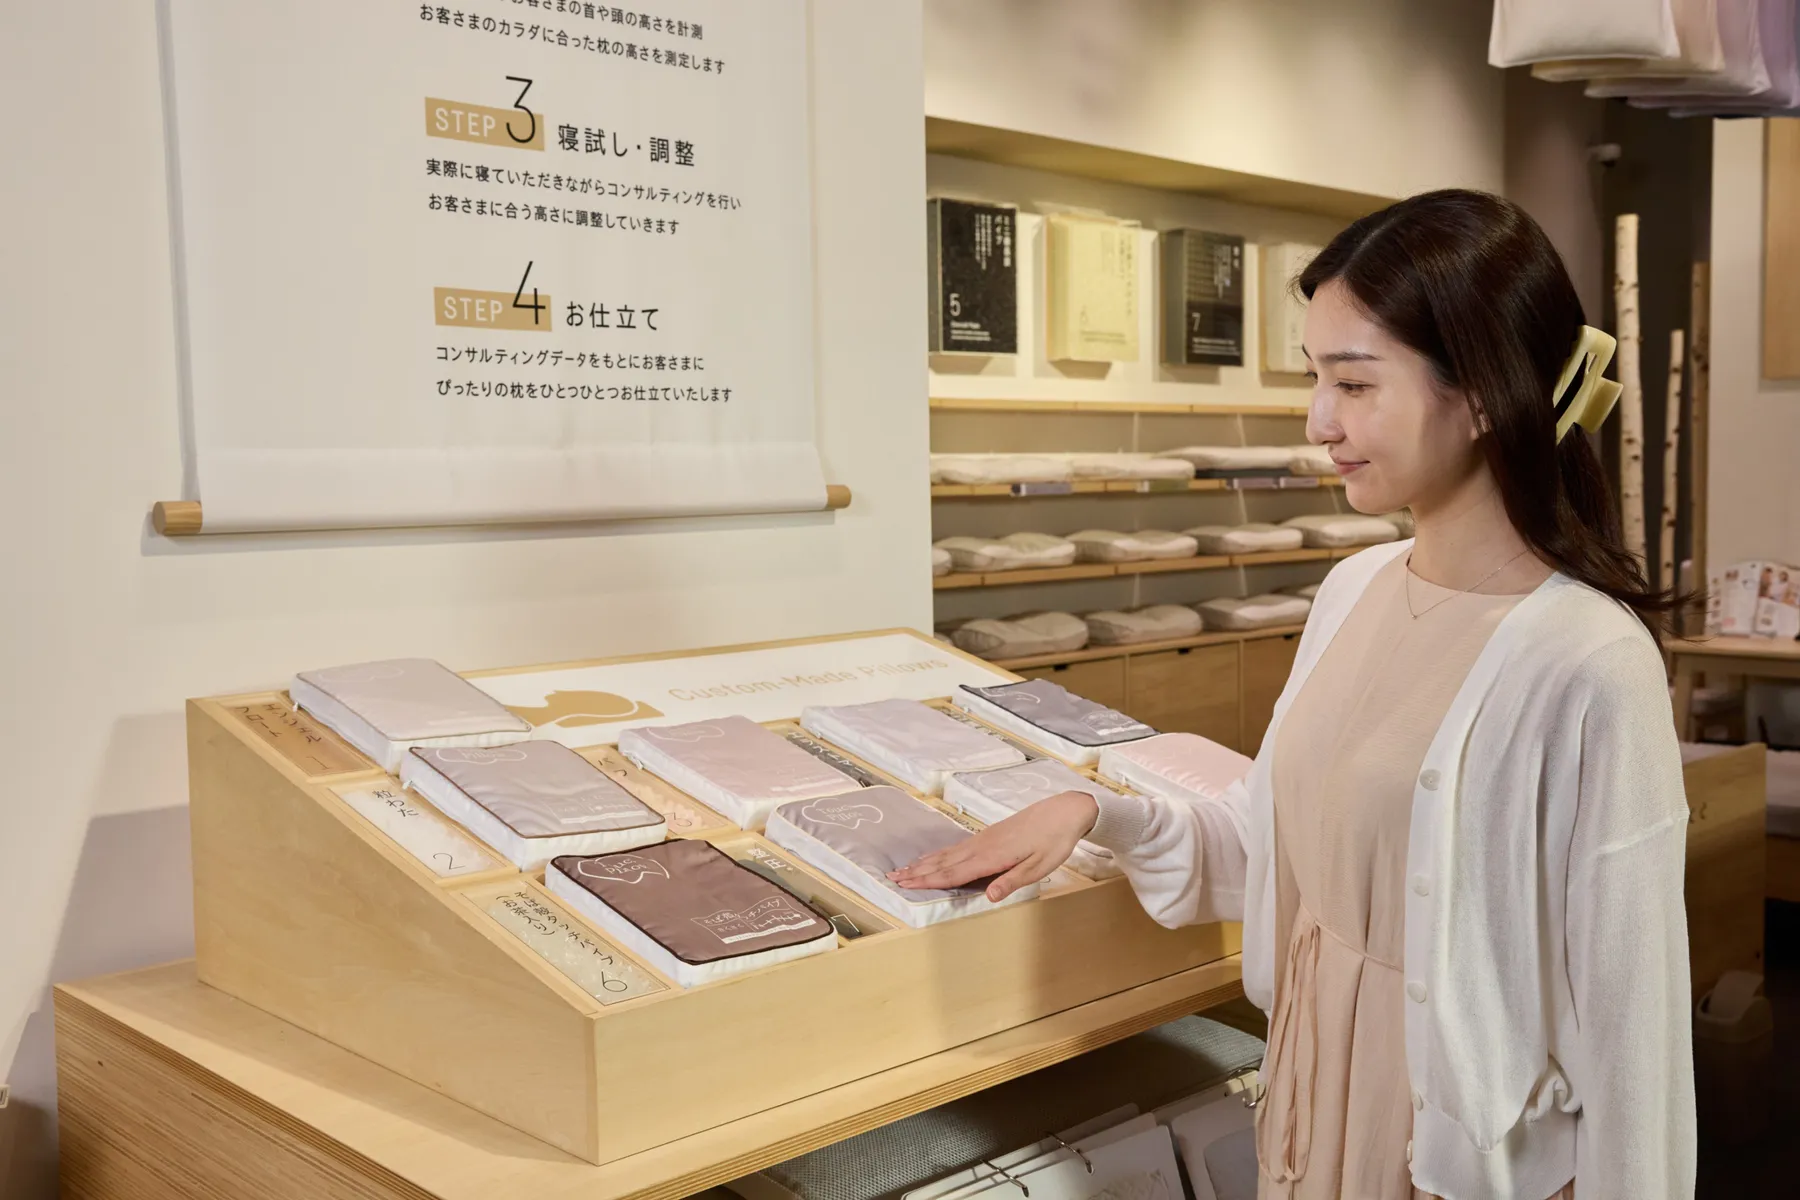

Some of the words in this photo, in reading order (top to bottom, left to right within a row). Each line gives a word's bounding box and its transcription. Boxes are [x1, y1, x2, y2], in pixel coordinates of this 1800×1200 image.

[420, 4, 725, 74] お客さまのカラダに合った枕の高さを測定します
[435, 107, 496, 138] STEP
[505, 75, 536, 144] 3
[558, 124, 695, 167] 寝試し・調整
[426, 158, 741, 210] 実際に寝ていただきながらコンサルティングを行い
[428, 193, 680, 235] お客さまに合う高さに調整していきます
[444, 296, 504, 323] STEP
[512, 260, 546, 325] 4
[566, 300, 659, 331] お仕立て
[949, 292, 961, 317] 5
[1192, 312, 1201, 332] 7
[436, 346, 705, 371] コンサルティングデータをもとにお客さまに
[436, 378, 732, 402] ぴったりの枕をひとつひとつお仕立ていたします
[668, 672, 857, 702] Custom-Made
[858, 658, 949, 677] Pillows
[372, 789, 420, 818] 粒わた
[432, 852, 466, 870] 2
[601, 971, 628, 992] 6
